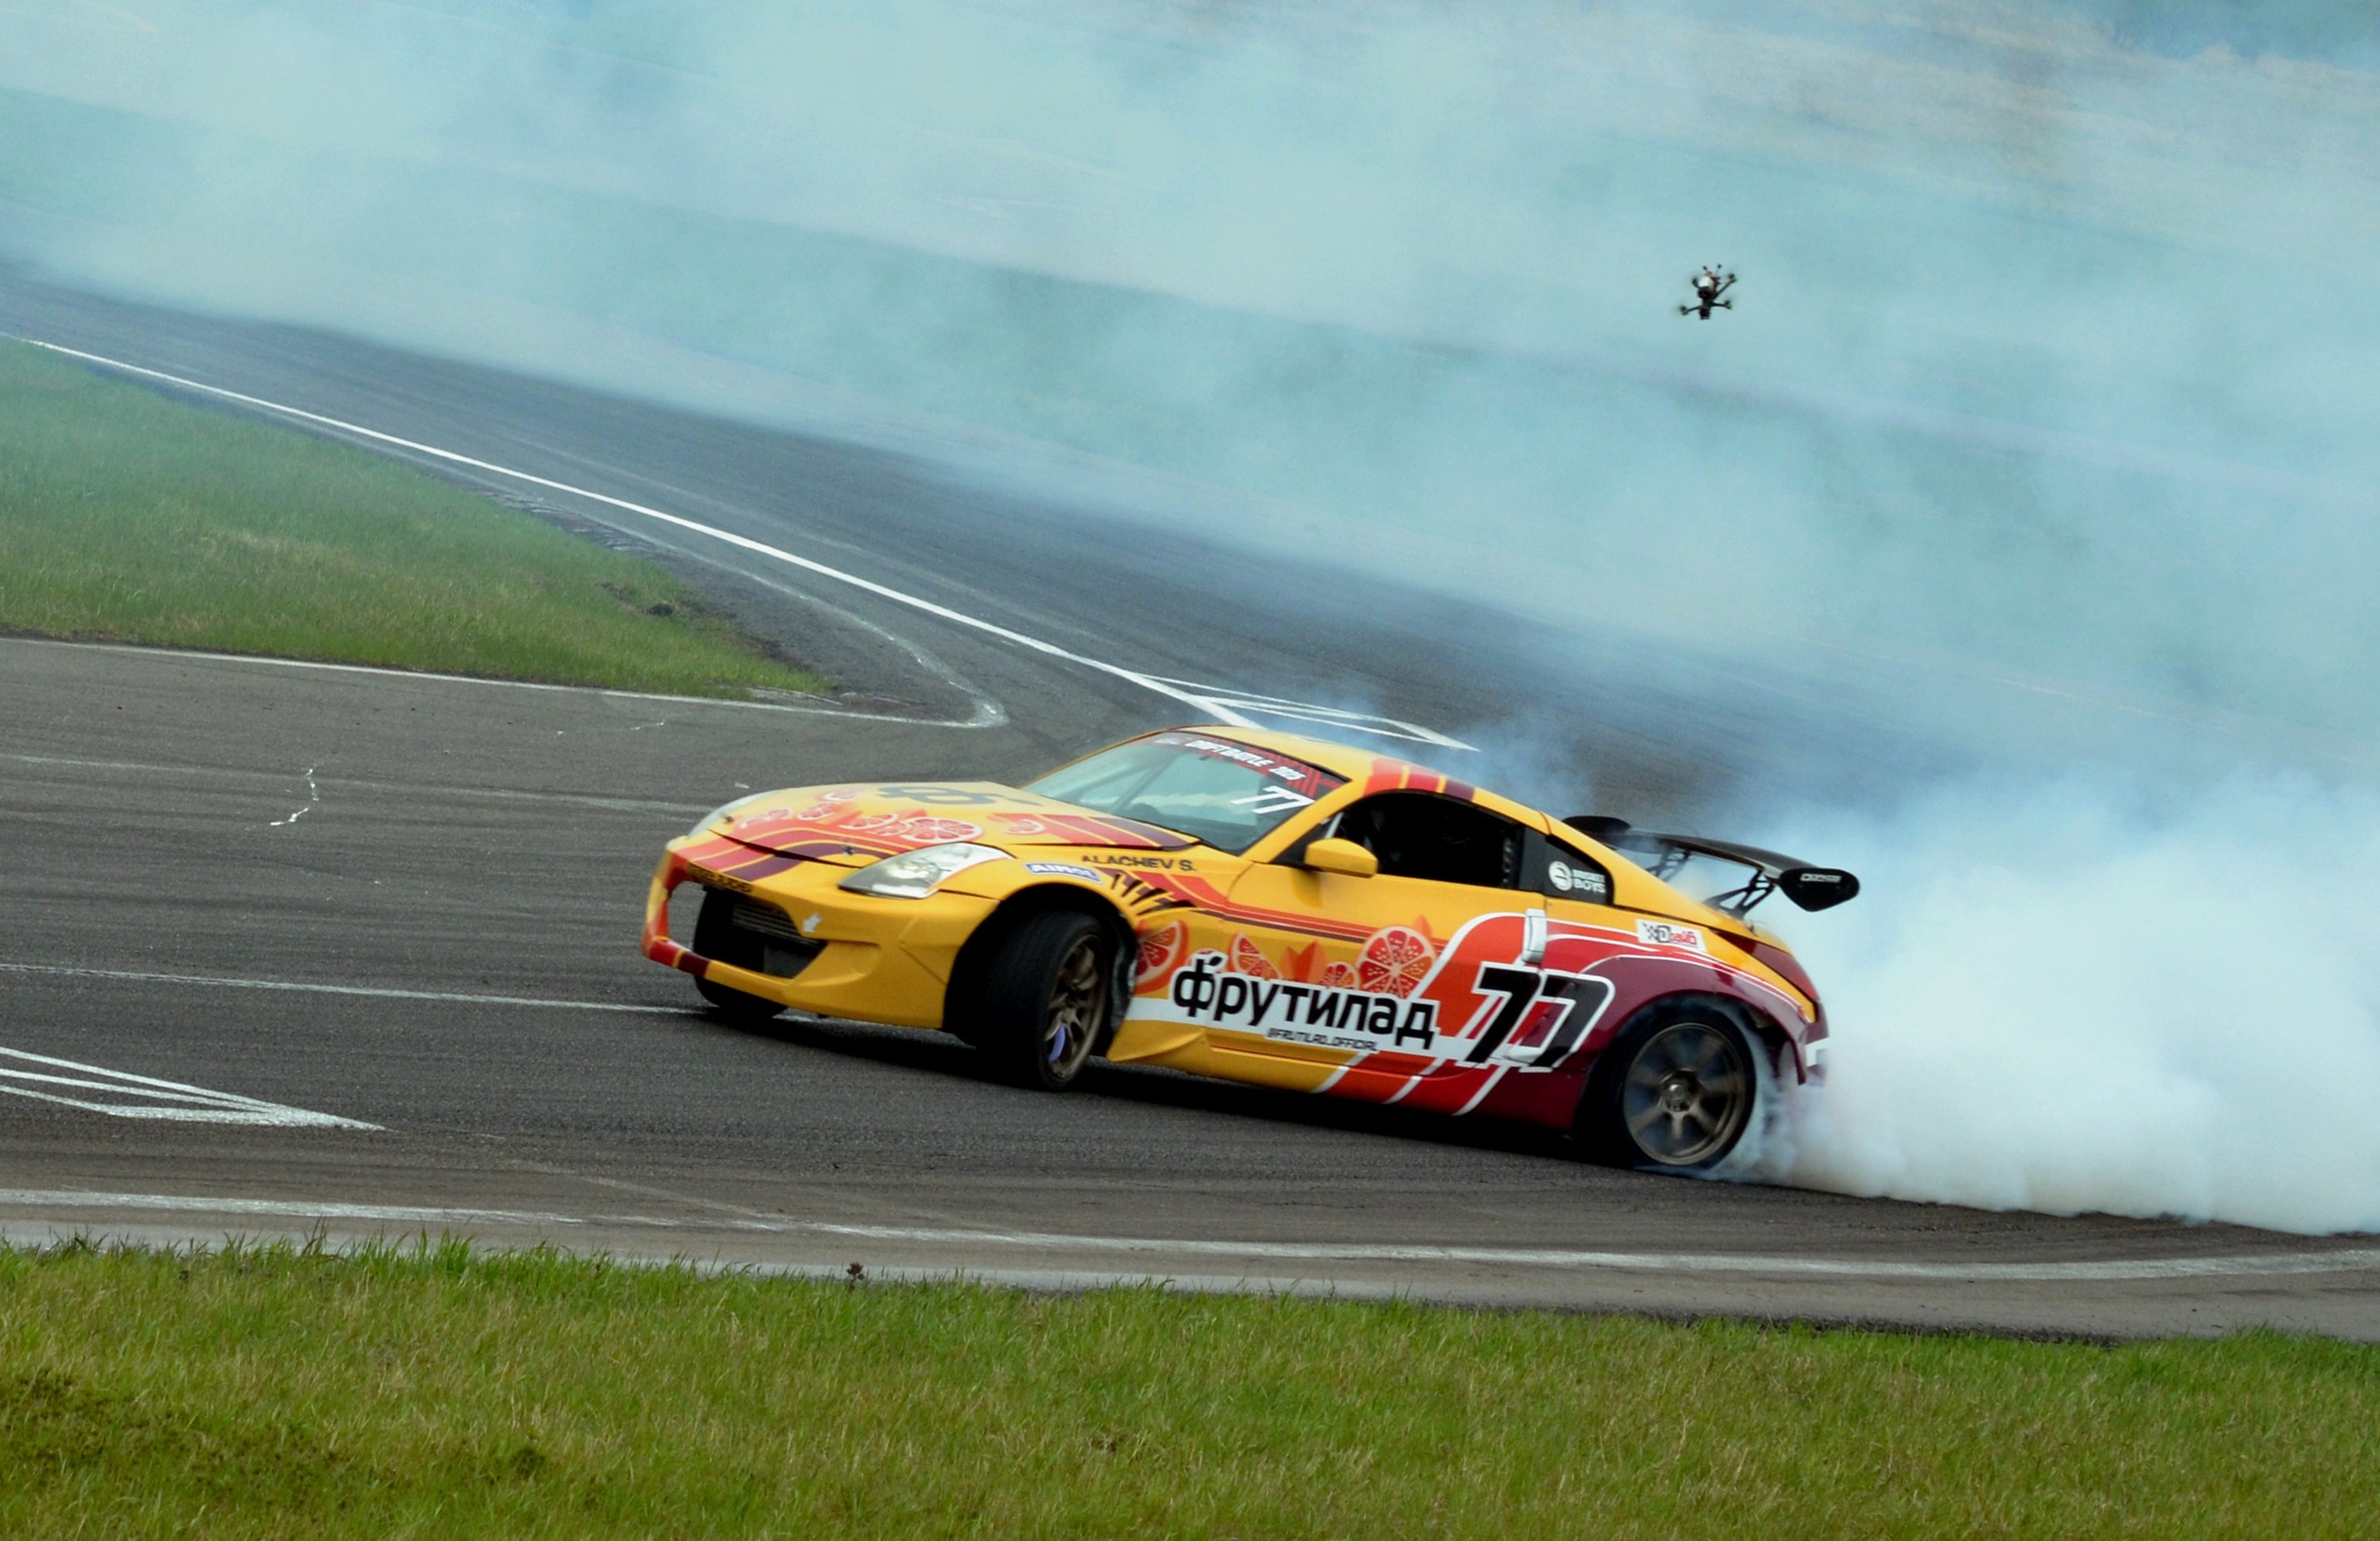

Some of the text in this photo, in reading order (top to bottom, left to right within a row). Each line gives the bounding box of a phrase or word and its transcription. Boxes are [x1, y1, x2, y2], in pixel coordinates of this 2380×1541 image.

[1230, 784, 1316, 814] 77
[1081, 855, 1197, 872] ALACHEV S.
[1461, 964, 1612, 1070] 77
